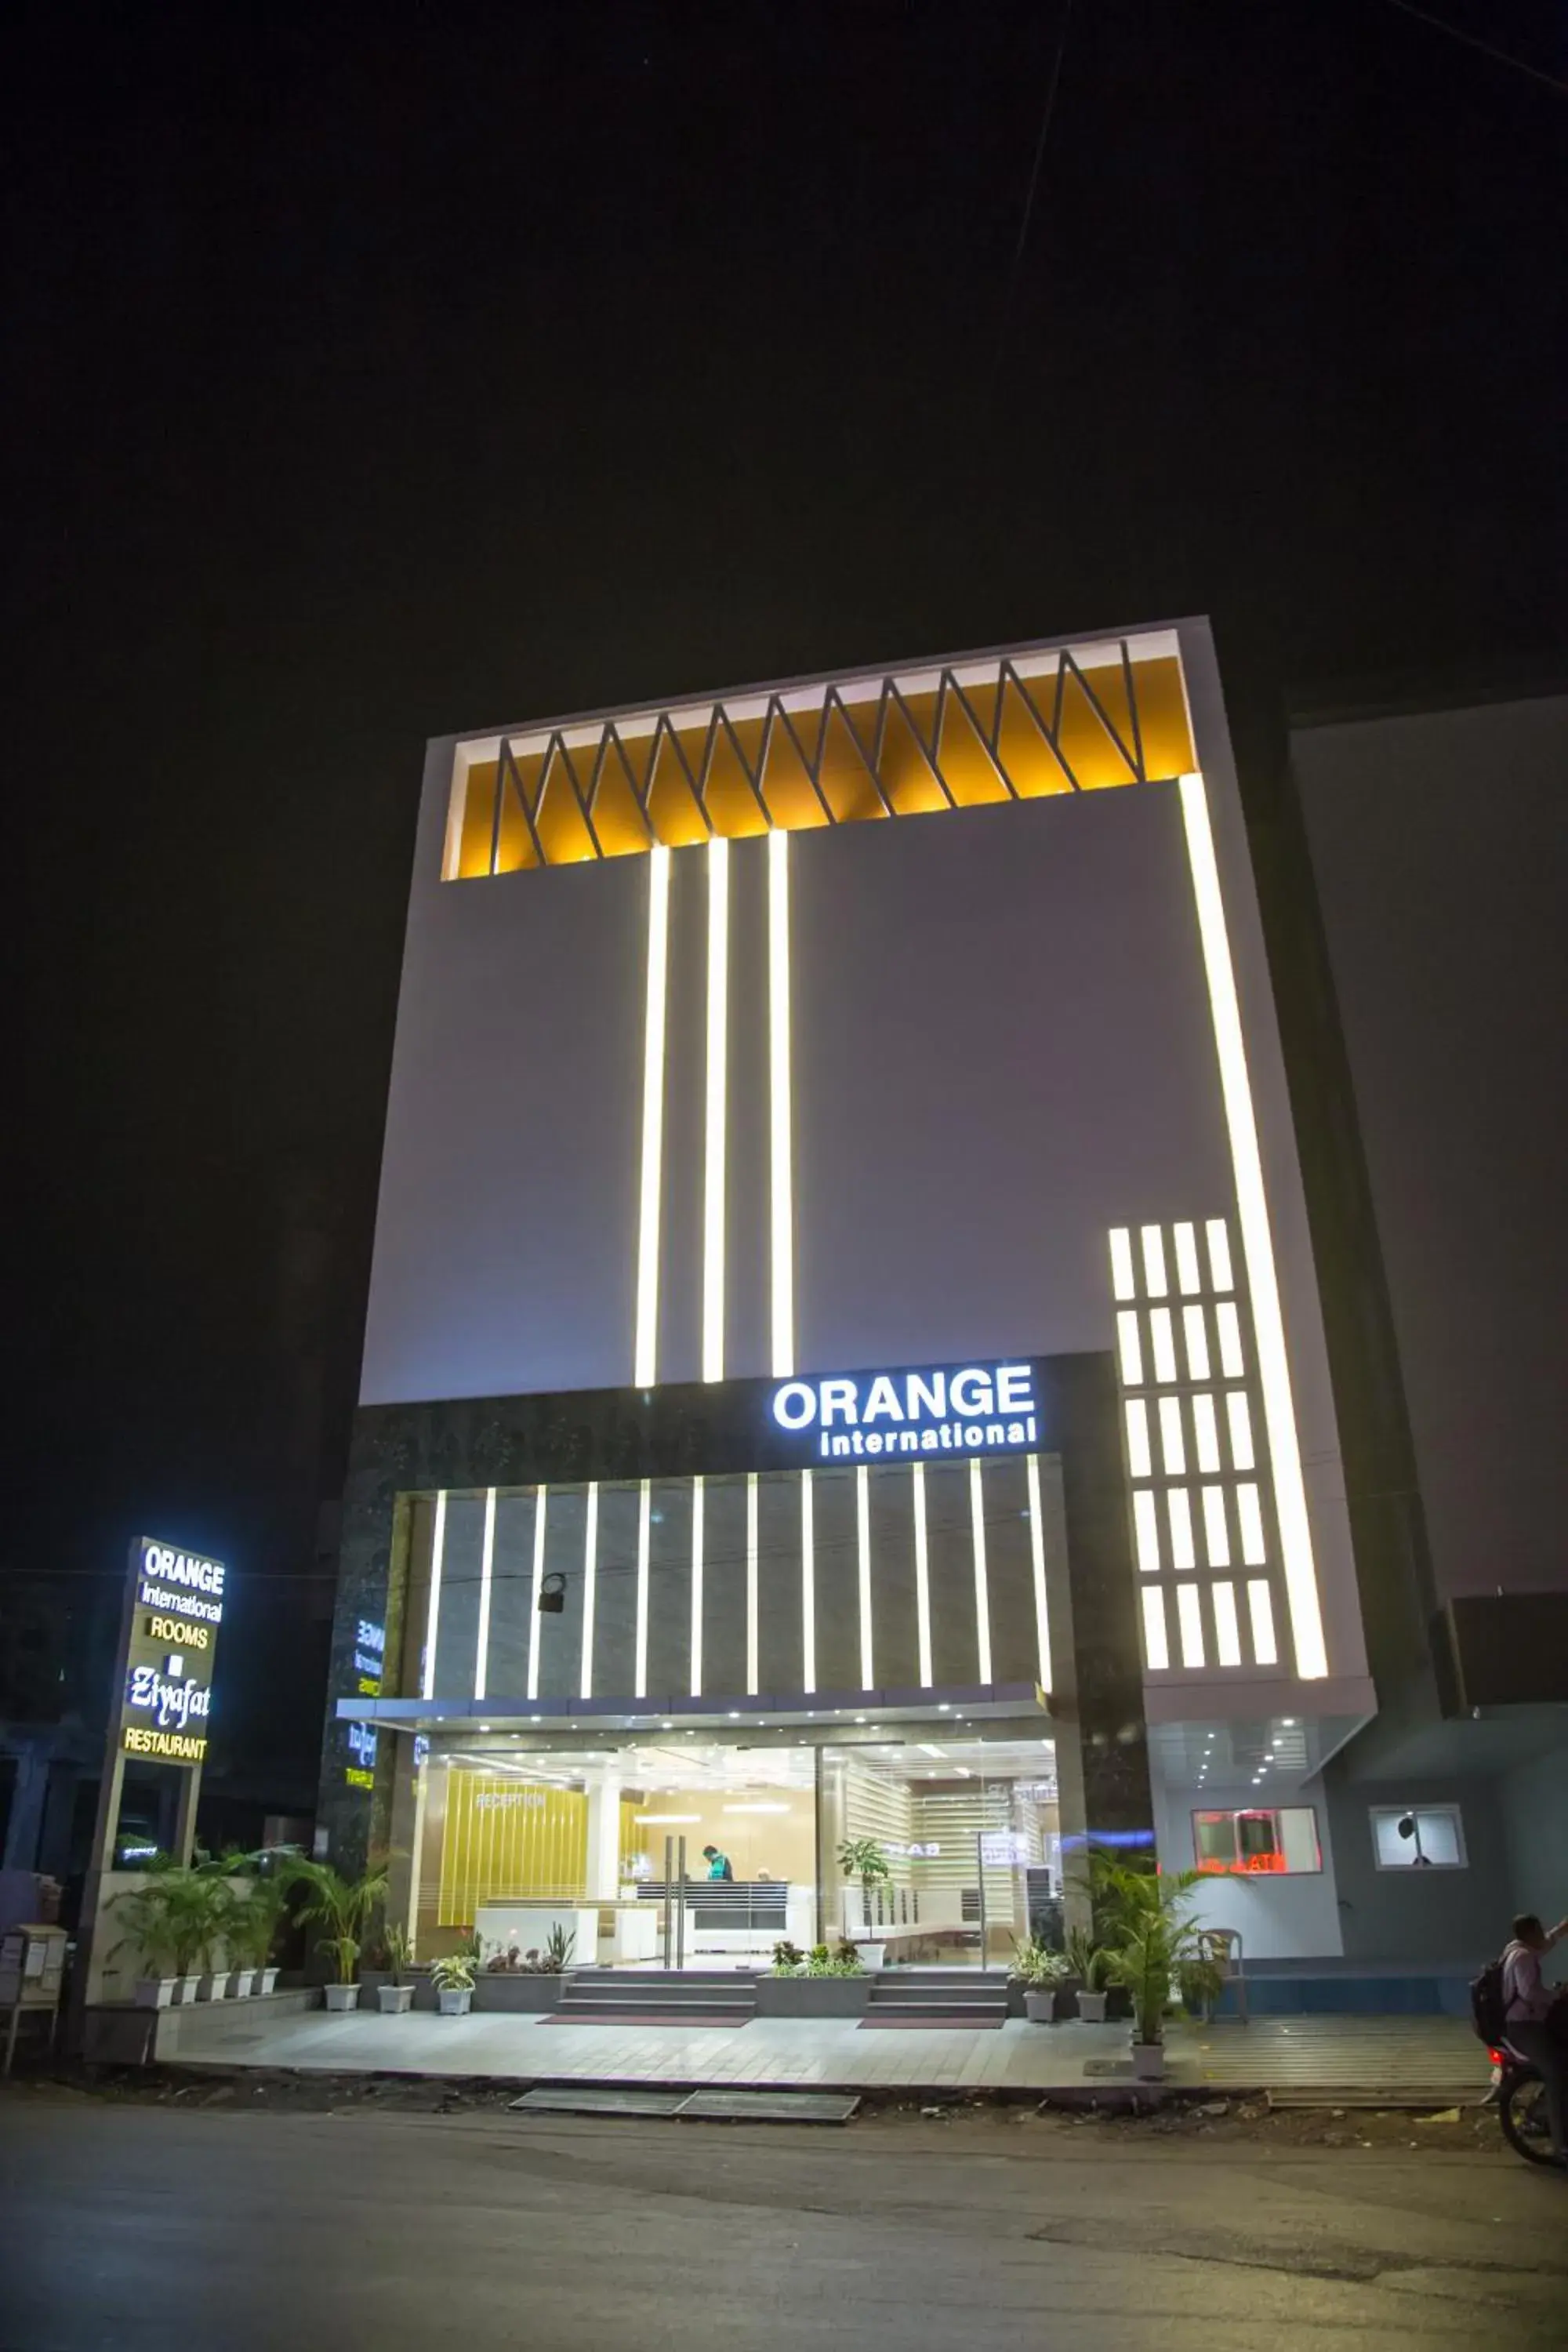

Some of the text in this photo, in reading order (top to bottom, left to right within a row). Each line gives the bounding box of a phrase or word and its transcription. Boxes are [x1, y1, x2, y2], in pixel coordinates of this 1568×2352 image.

[772, 1365, 1036, 1430] ORANGE
[820, 1417, 1037, 1457] International
[145, 1545, 225, 1595] ORANGE
[141, 1581, 223, 1623] International
[150, 1616, 208, 1650] ROOMS
[131, 1666, 211, 1729] Ziyafat
[125, 1727, 208, 1760] RESTAURANT
